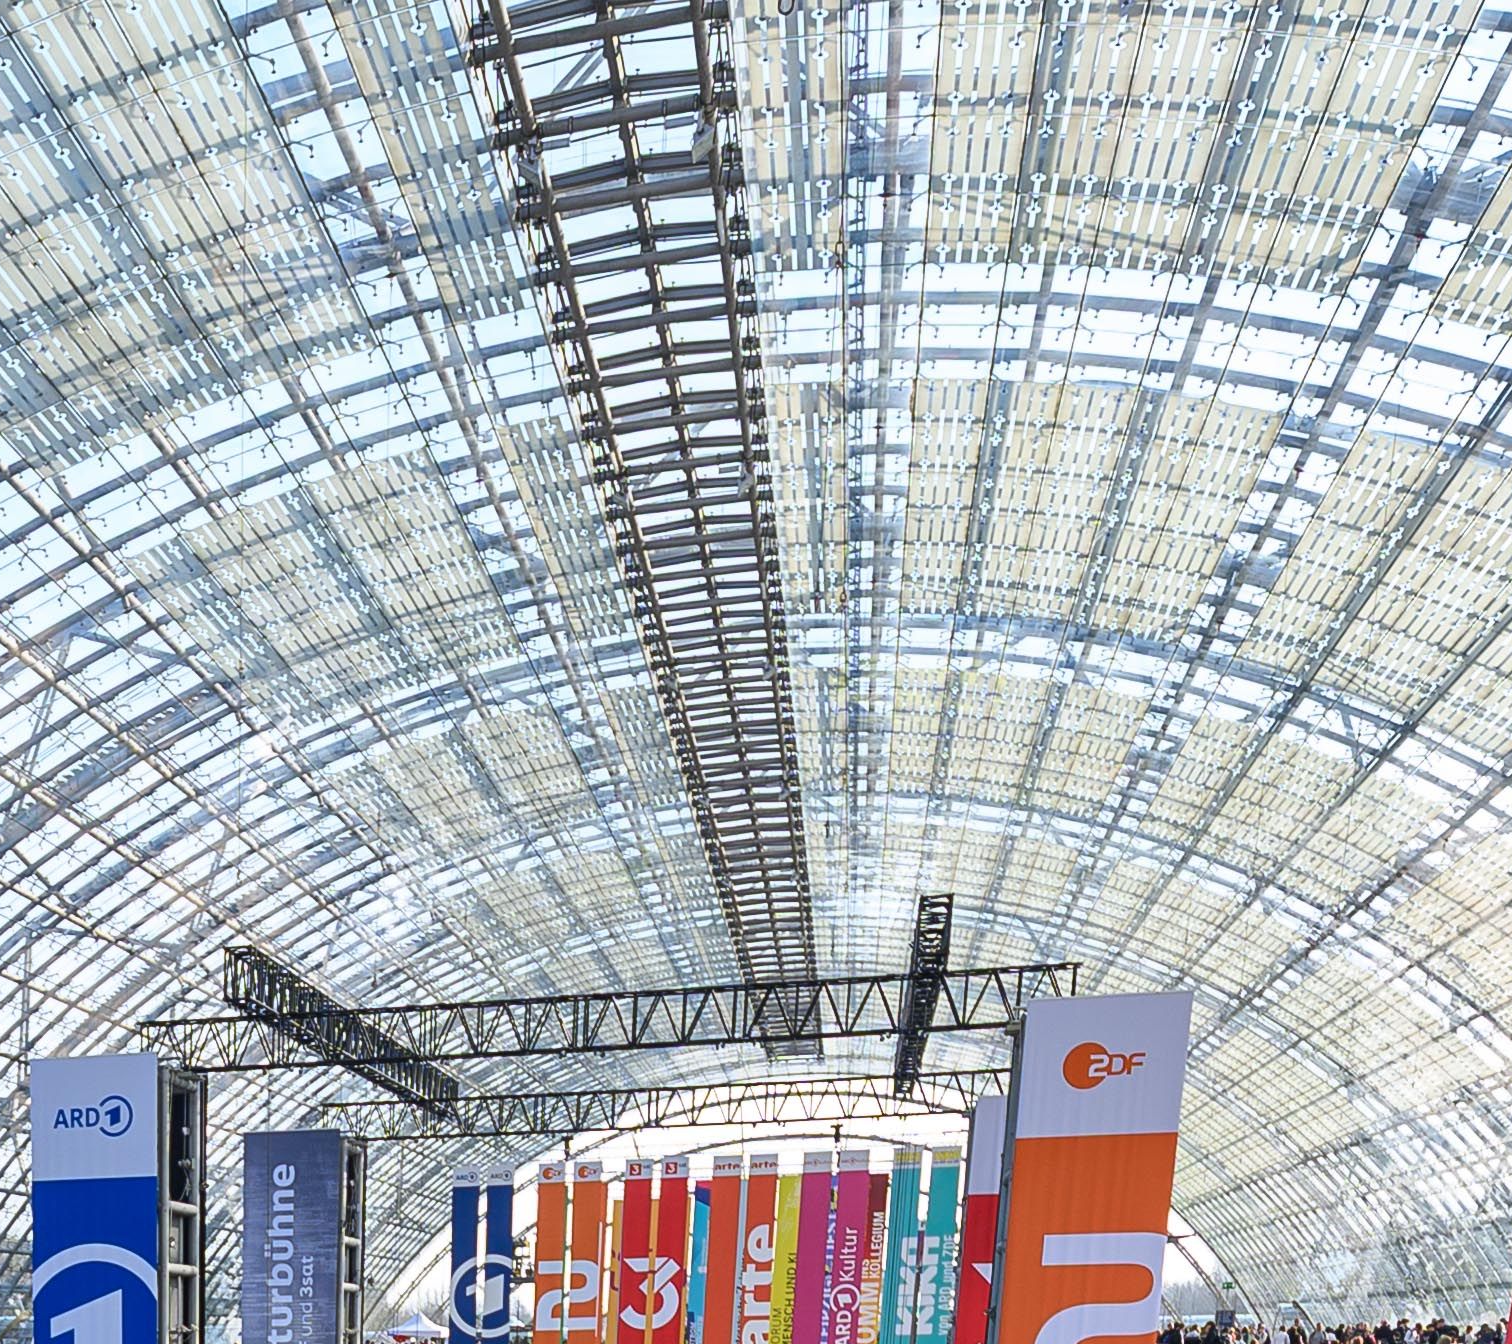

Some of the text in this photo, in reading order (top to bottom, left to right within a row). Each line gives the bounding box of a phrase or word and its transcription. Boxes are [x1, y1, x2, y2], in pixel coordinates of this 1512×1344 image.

[1087, 1053, 1146, 1078] ZDF
[53, 1107, 100, 1130] ARD
[714, 1162, 740, 1171] arte
[750, 1160, 777, 1170] arte
[839, 1226, 858, 1282] Kultur
[869, 1211, 885, 1279] KOLLEGIUM
[298, 1255, 314, 1298] 3sat
[786, 1267, 797, 1298] UND
[299, 1301, 314, 1337] und
